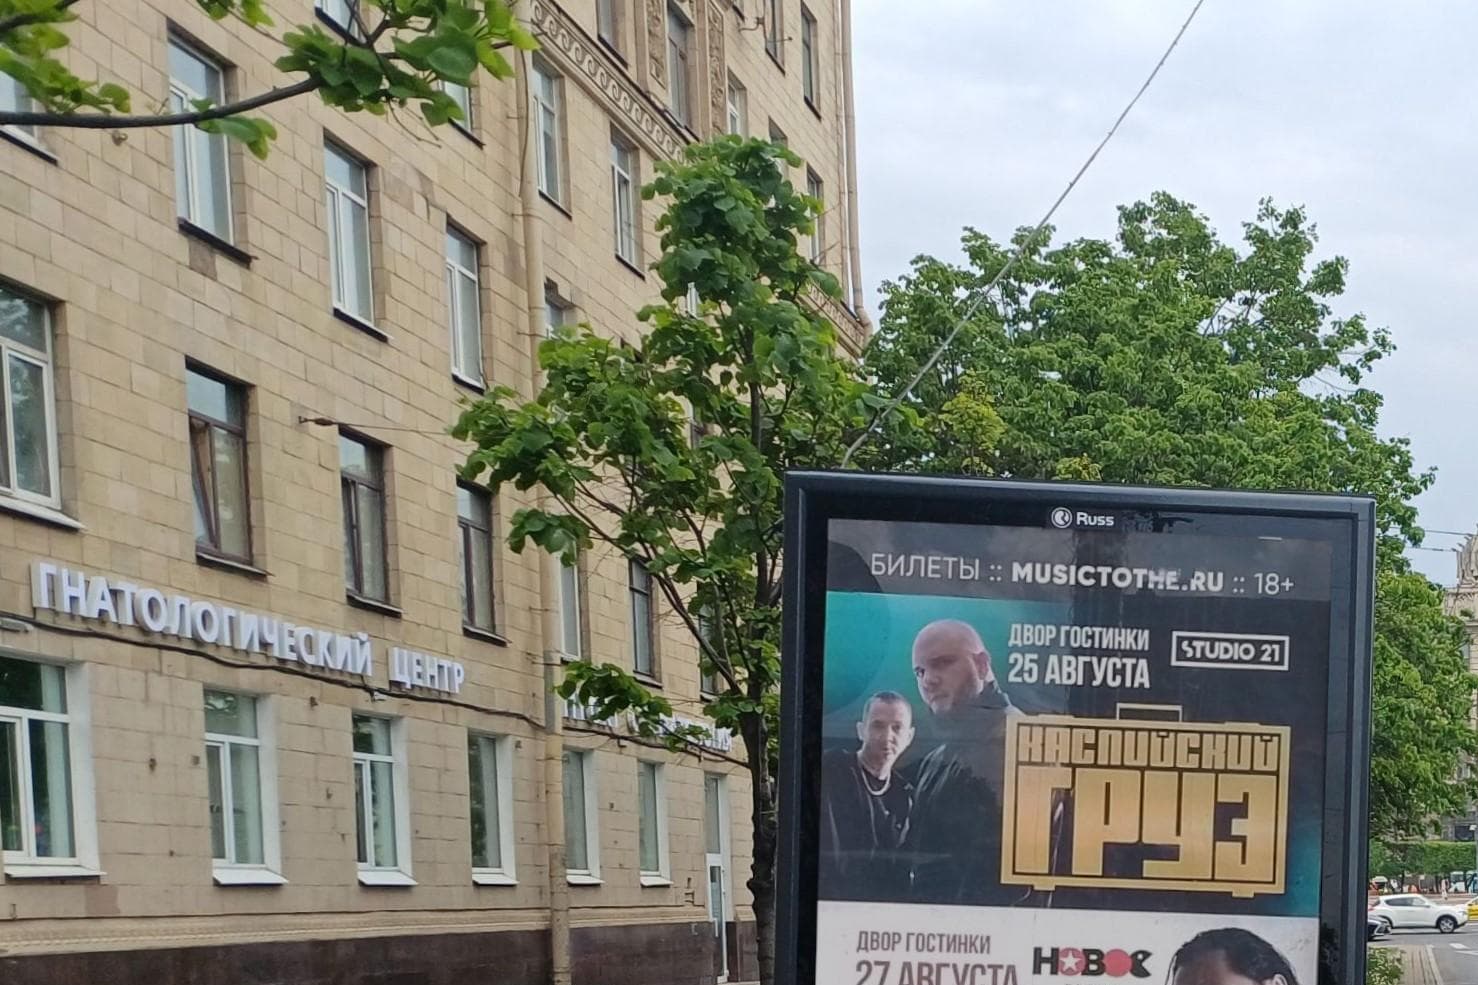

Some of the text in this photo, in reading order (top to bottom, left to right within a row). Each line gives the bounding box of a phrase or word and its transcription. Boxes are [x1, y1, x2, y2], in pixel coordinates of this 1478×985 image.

[1076, 511, 1115, 527] Russ
[870, 553, 980, 581] БИЛЕТЫ
[1011, 562, 1224, 592] MUSICTOTHE.RU
[1253, 572, 1295, 595] 18+
[31, 562, 466, 694] ГНАТОЛОГИЧЕСКИЙ ЦЕНТР
[1007, 623, 1150, 651] ДВОР ГОСТИНКИ
[1180, 640, 1281, 663] STUDIO 21
[1007, 652, 1151, 689] 25 АВГУСТА
[1017, 724, 1280, 772] КАСПИЙСКИЙ
[1013, 766, 1278, 883] ГРУЗ
[856, 930, 991, 955] ДВОР ГОСТИНКИ
